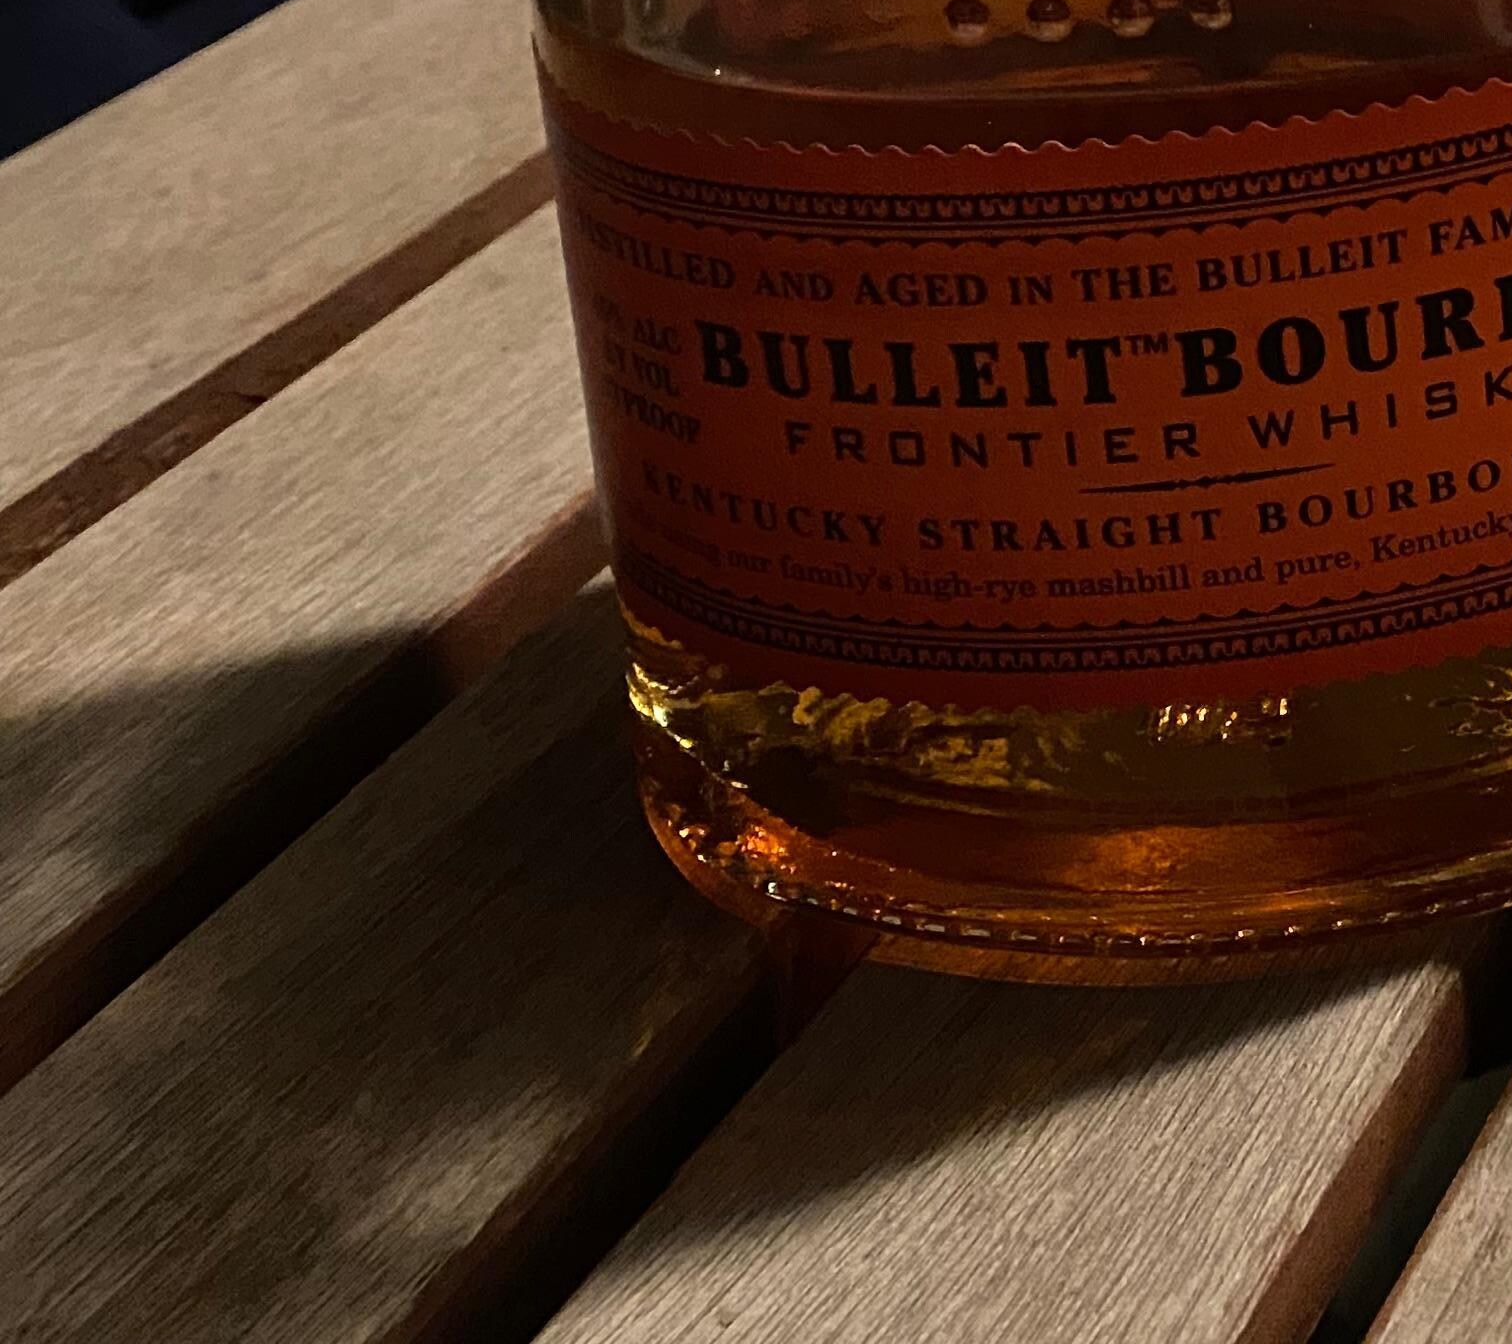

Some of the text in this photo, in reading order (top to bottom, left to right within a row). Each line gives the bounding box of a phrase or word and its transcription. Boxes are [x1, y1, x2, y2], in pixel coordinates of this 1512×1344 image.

[753, 268, 834, 302] AND
[854, 273, 988, 307] AGED
[1008, 274, 1054, 306] IN
[1072, 261, 1178, 302] THE
[1197, 229, 1408, 293] BULLEIT
[784, 419, 1200, 469] FRONTIER
[641, 459, 886, 546] KENTUCKY
[919, 507, 1221, 554] STRAIGHT
[727, 548, 774, 574] our
[780, 555, 893, 595] family's
[901, 568, 1038, 601] high-rye
[1047, 551, 1192, 598] mashbill
[1202, 546, 1265, 590] and
[1275, 546, 1361, 596] pure,
